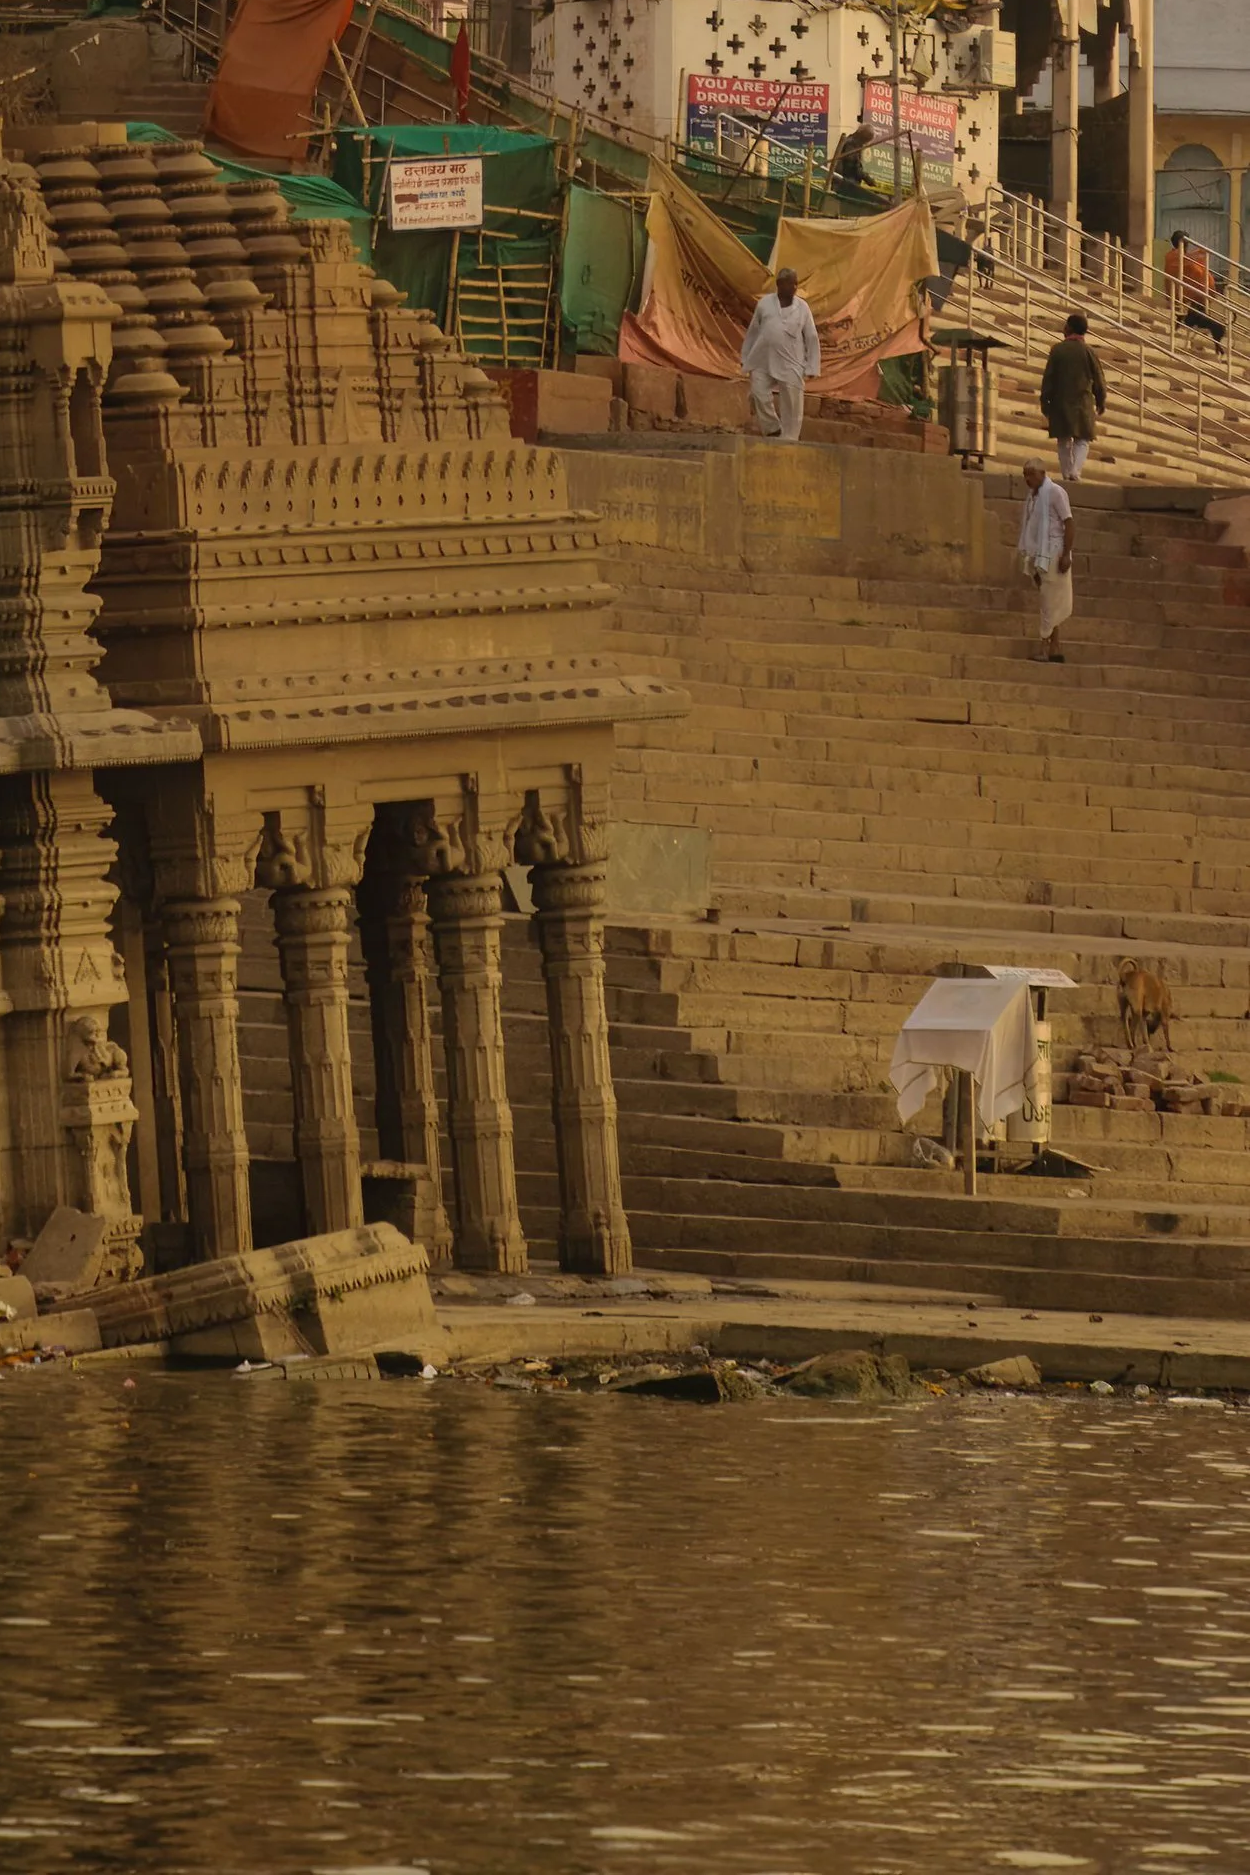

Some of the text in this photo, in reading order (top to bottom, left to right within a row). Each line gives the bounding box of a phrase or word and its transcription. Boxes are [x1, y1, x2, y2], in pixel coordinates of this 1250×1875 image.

[695, 77, 825, 97] YOU ARE UNDER
[696, 91, 823, 110] DRONE CAMERA
[871, 84, 892, 97] YOU
[919, 95, 954, 114] UNDER
[871, 98, 952, 128] DROE CAMERA
[871, 112, 950, 141] SUREILLANCE
[873, 148, 893, 161] BAL
[1022, 1101, 1050, 1123] USE
